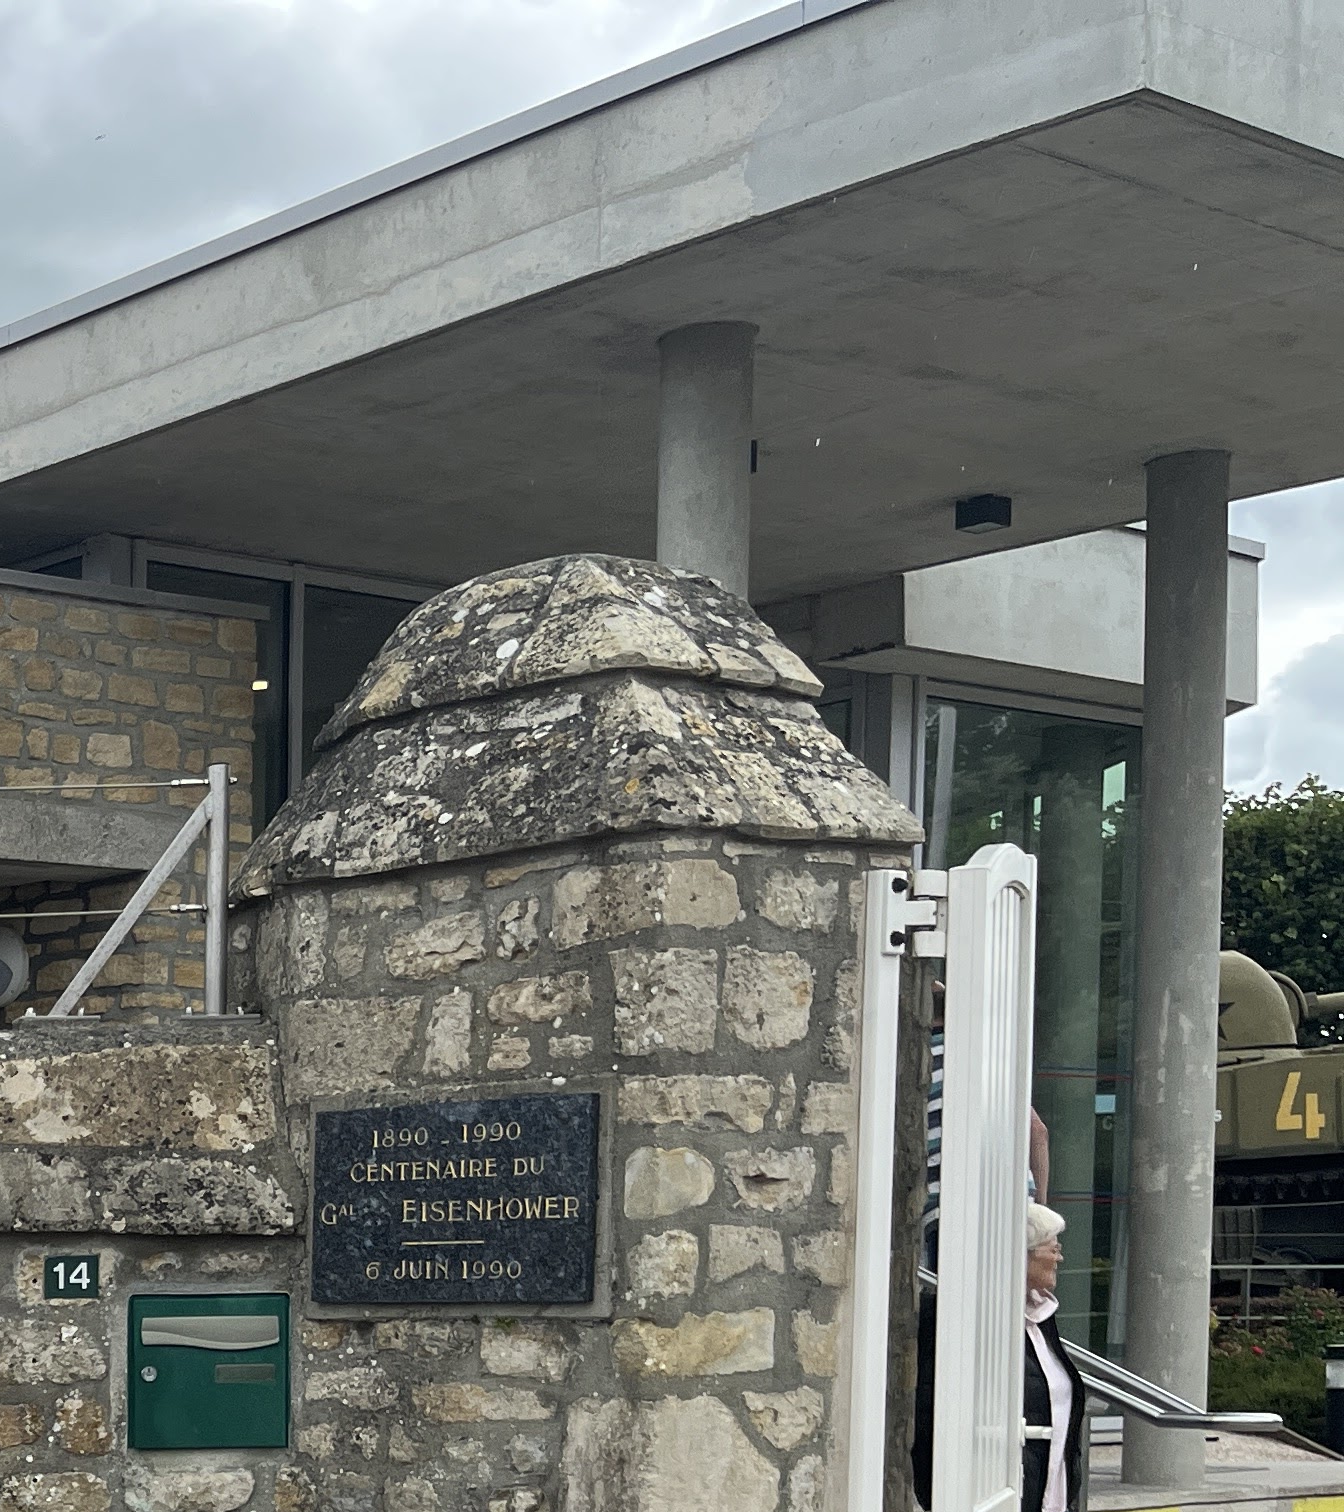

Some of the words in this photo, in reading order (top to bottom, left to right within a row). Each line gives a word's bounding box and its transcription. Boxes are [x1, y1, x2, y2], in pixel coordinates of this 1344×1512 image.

[1275, 1071, 1326, 1139] 4
[372, 1126, 429, 1148] 1890
[461, 1121, 522, 1143] 1990
[349, 1157, 498, 1183] CENTENAIRE
[513, 1155, 545, 1176] DU
[402, 1196, 580, 1223] EISENHOWER
[52, 1261, 91, 1290] 14
[365, 1261, 379, 1280] 6
[393, 1260, 450, 1280] JUIN
[461, 1259, 522, 1280] 1990
